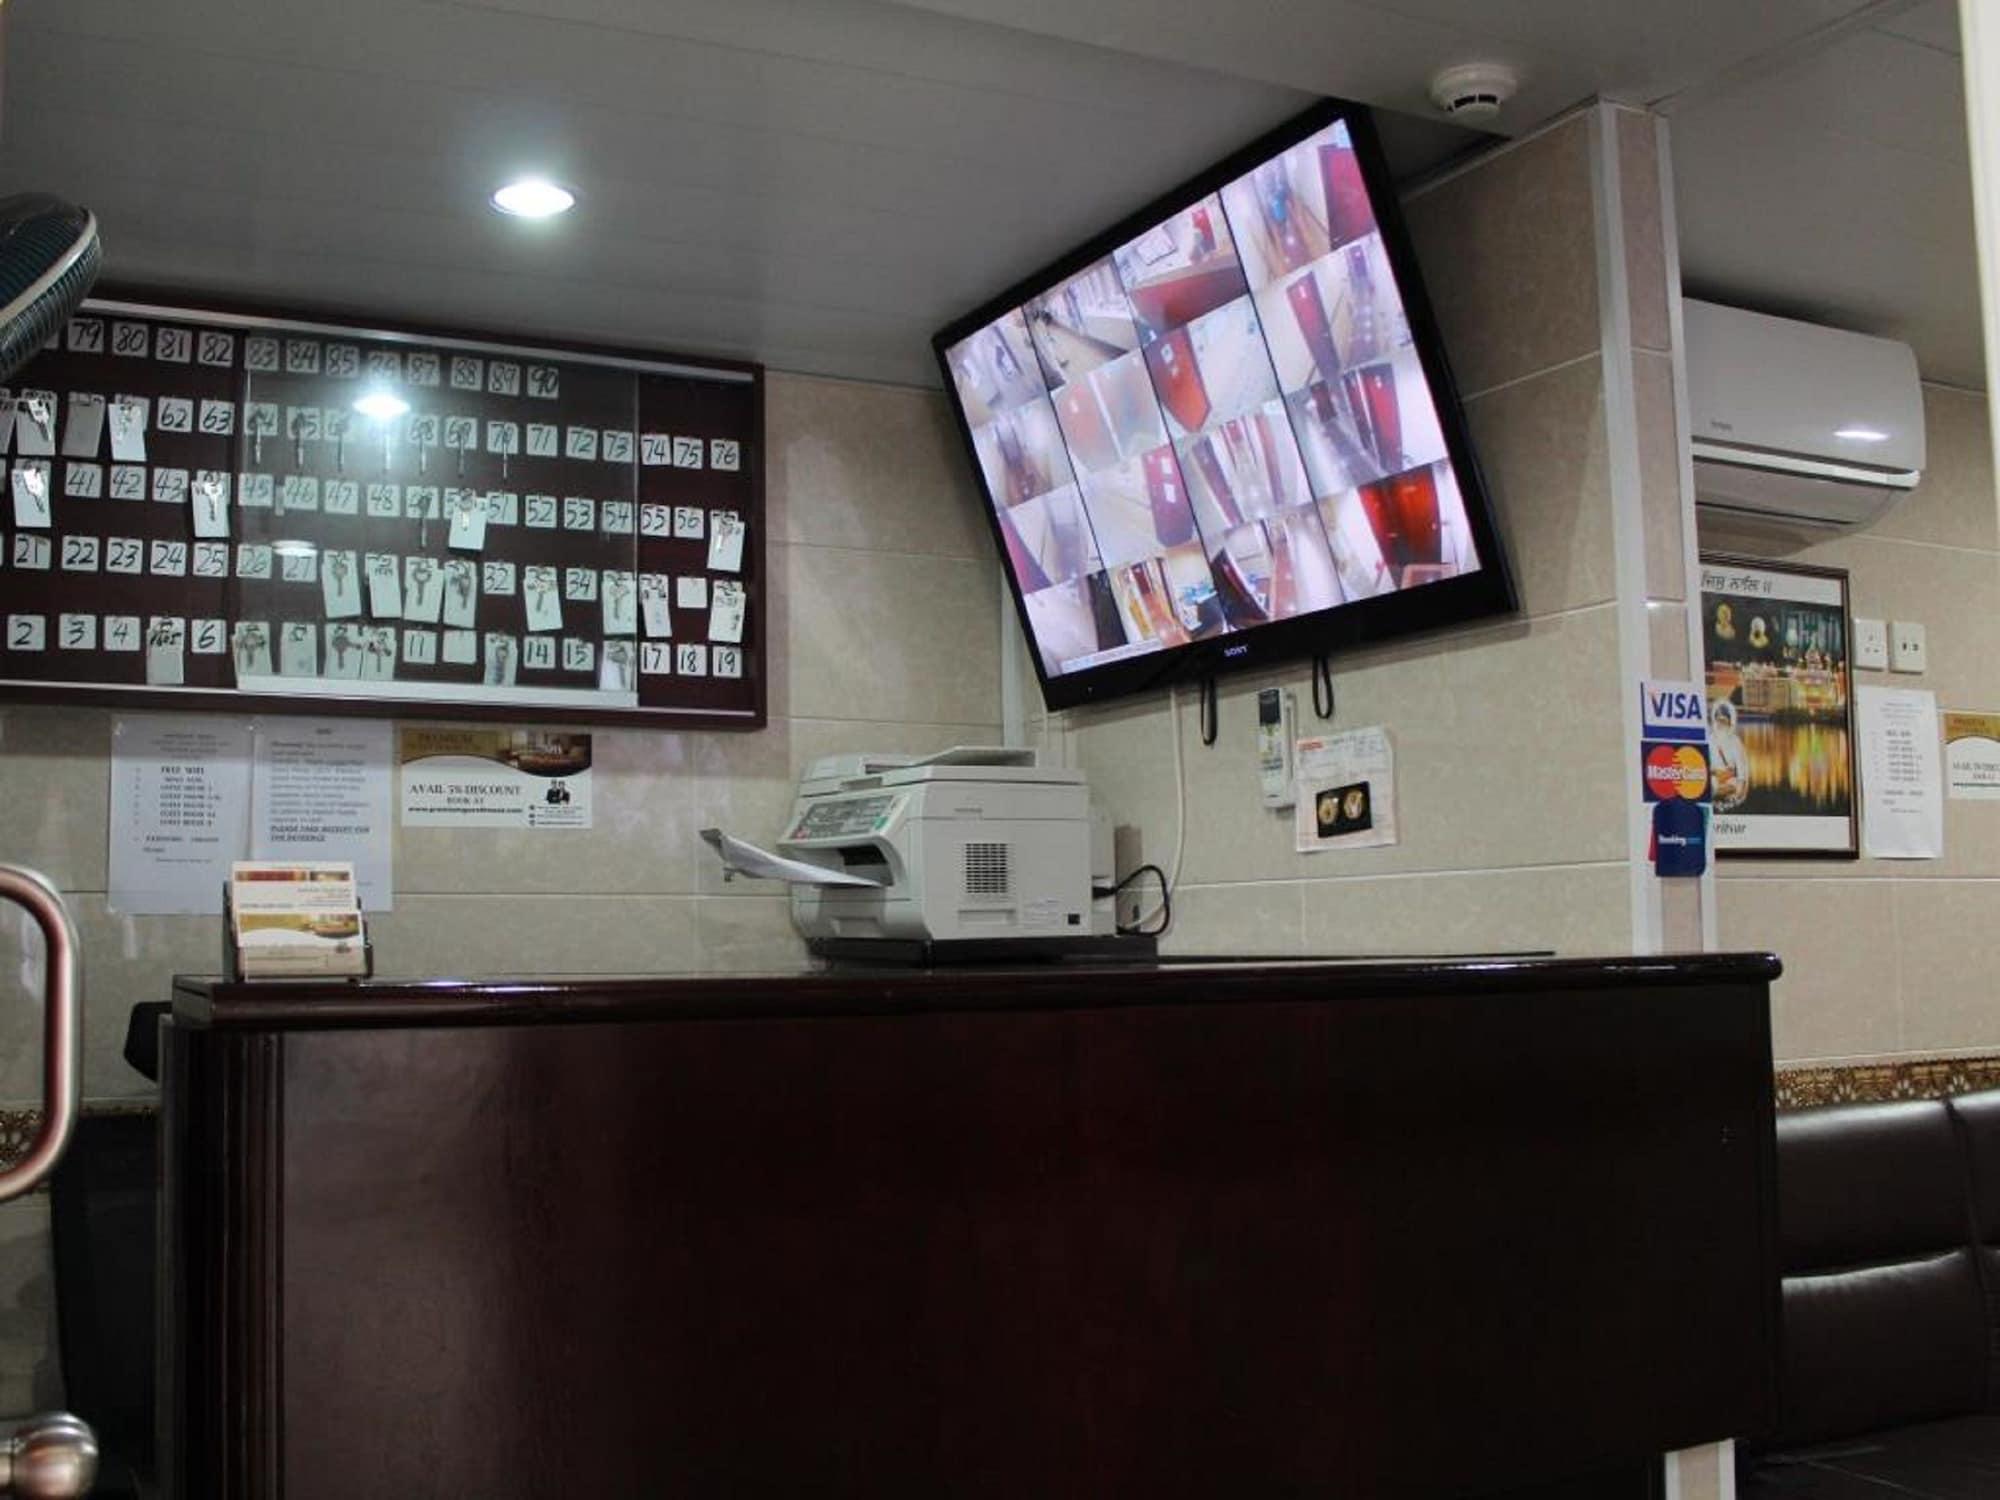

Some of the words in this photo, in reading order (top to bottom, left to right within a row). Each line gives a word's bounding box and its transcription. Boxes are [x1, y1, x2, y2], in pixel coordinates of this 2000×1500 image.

[72, 321, 101, 344] 79
[115, 325, 146, 351] 80
[158, 329, 187, 358] 81
[201, 333, 232, 363] 82
[530, 367, 559, 395] 90
[160, 402, 187, 429] 62
[202, 405, 232, 431] 63
[531, 426, 552, 451] 71
[568, 429, 594, 455] 72
[605, 432, 631, 460] 73
[643, 438, 666, 464] 74
[675, 441, 700, 467] 75
[714, 442, 737, 465] 76
[67, 466, 96, 492] 41
[111, 466, 142, 495] 42
[155, 471, 185, 501] 43
[487, 492, 511, 520] 51
[528, 497, 554, 524] 52
[566, 499, 592, 527] 53
[604, 503, 630, 529] 54
[643, 505, 665, 531] 55
[676, 507, 701, 531] 56
[65, 540, 97, 566] 22
[108, 542, 141, 568] 23
[152, 543, 183, 570] 24
[196, 545, 225, 576] 25
[485, 565, 510, 593] 32
[567, 569, 593, 597] 34
[14, 622, 34, 646] 2
[69, 619, 86, 646] 3
[112, 622, 130, 645] 4
[199, 624, 216, 650] 6
[408, 633, 426, 658] 11
[526, 641, 549, 665] 14
[566, 642, 589, 667] 15
[642, 647, 663, 671] 17
[679, 649, 698, 674] 18
[716, 650, 737, 675] 19
[1224, 645, 1248, 657] SONY
[1651, 692, 1703, 720] VISA
[410, 784, 446, 796] AVAIL
[465, 785, 521, 797] DISCOUNT
